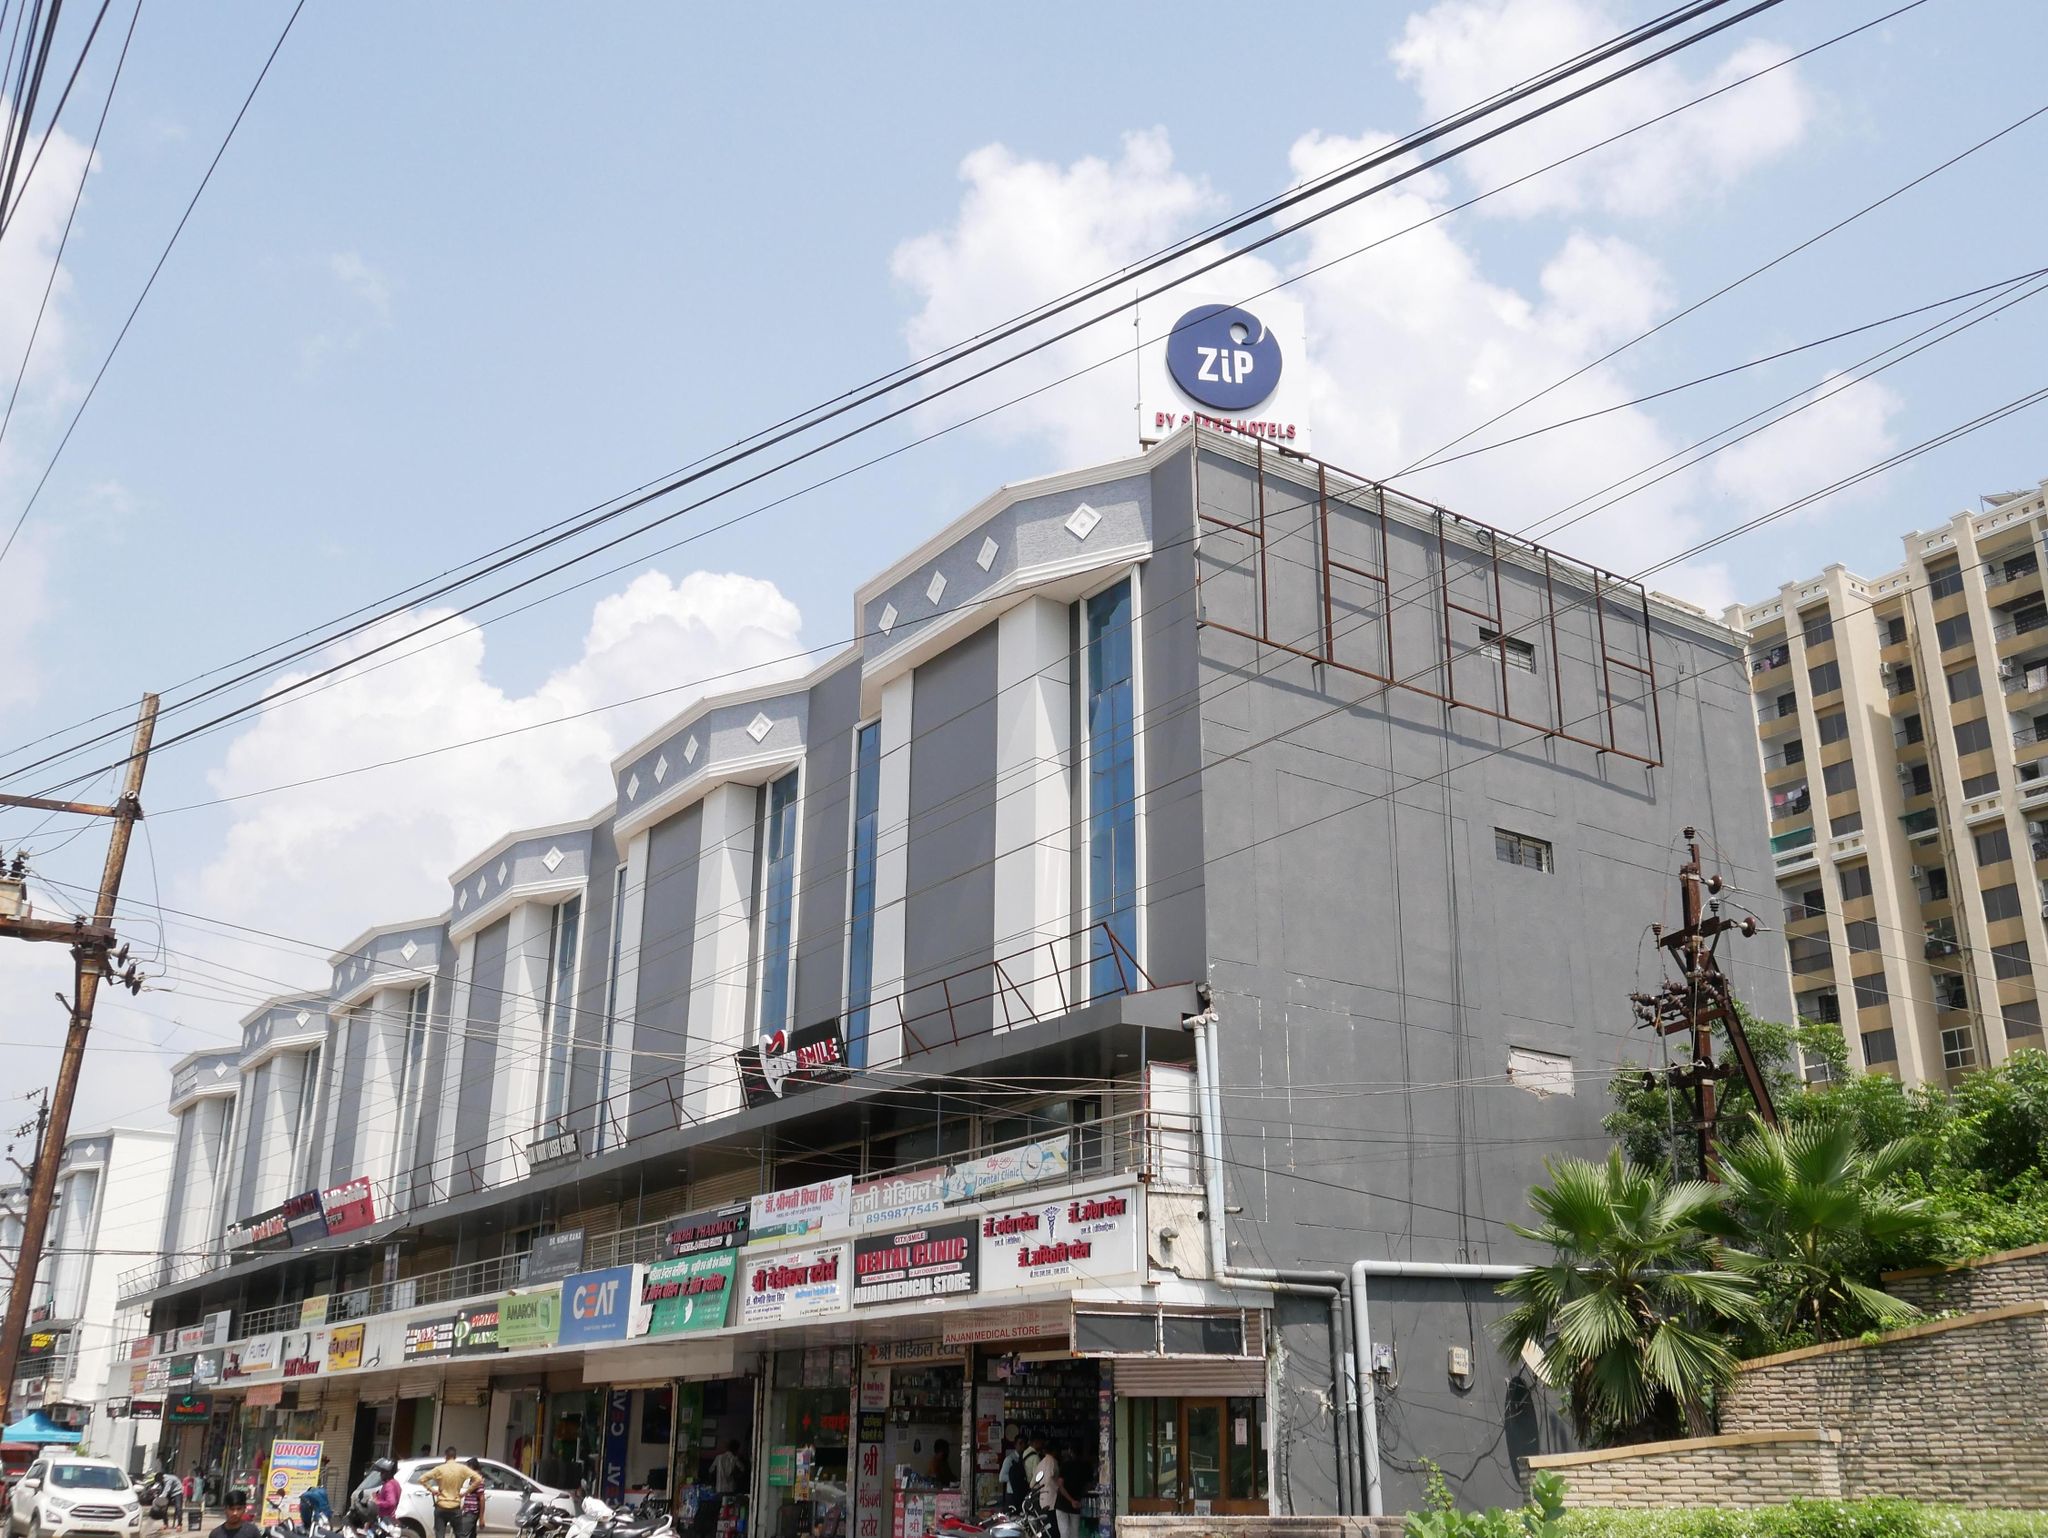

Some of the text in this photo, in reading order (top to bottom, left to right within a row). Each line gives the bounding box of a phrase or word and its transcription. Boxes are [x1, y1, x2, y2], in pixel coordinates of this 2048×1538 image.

[1155, 412, 1176, 428] BY
[1236, 418, 1296, 439] HOTELS
[979, 1167, 1020, 1187] Dental Clinic
[883, 1179, 932, 1207] मेडिकल
[866, 1201, 940, 1224] 8959877545
[697, 1219, 738, 1238] PHARMACY
[895, 1232, 925, 1244] CITY SMILE
[856, 1237, 968, 1274] DENTAL CLINIC
[853, 1284, 888, 1303] ANJANI
[888, 1277, 933, 1300] MEDICAL
[934, 1272, 971, 1295] STORE
[573, 1280, 619, 1320] CEAT
[507, 1302, 537, 1320] AMARON
[945, 1325, 1040, 1344] ANJANI MEDICAL STORE
[879, 1343, 891, 1360] श्री
[275, 1443, 318, 1457] UNIQUE
[863, 1444, 878, 1477] श्री
